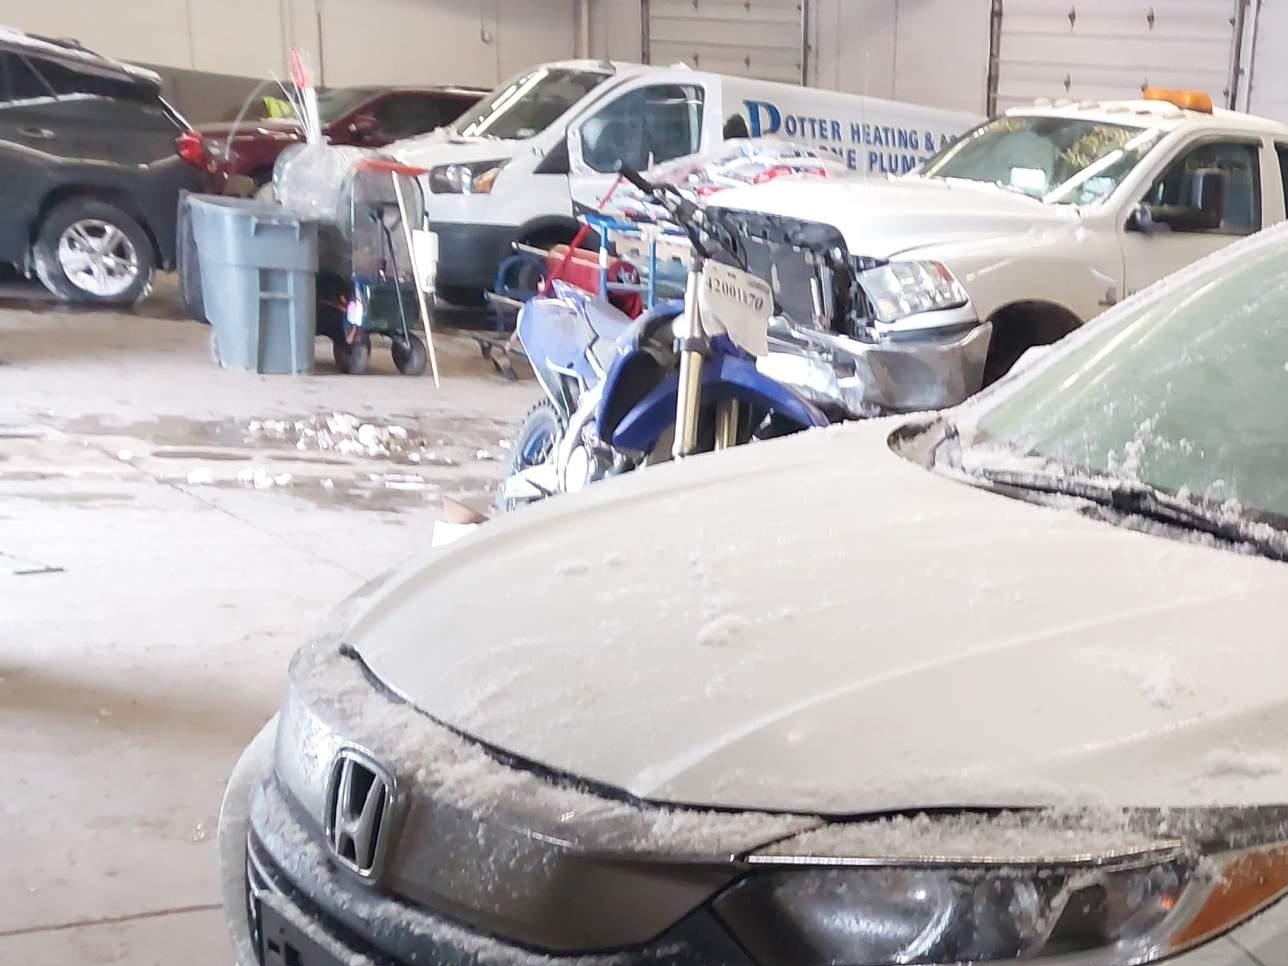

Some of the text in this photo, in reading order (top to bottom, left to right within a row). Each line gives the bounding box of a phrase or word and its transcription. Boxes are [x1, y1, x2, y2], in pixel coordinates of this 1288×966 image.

[742, 99, 842, 142] POTTER
[850, 122, 919, 151] HEATING
[924, 130, 935, 151] &
[869, 150, 929, 174] PLUM
